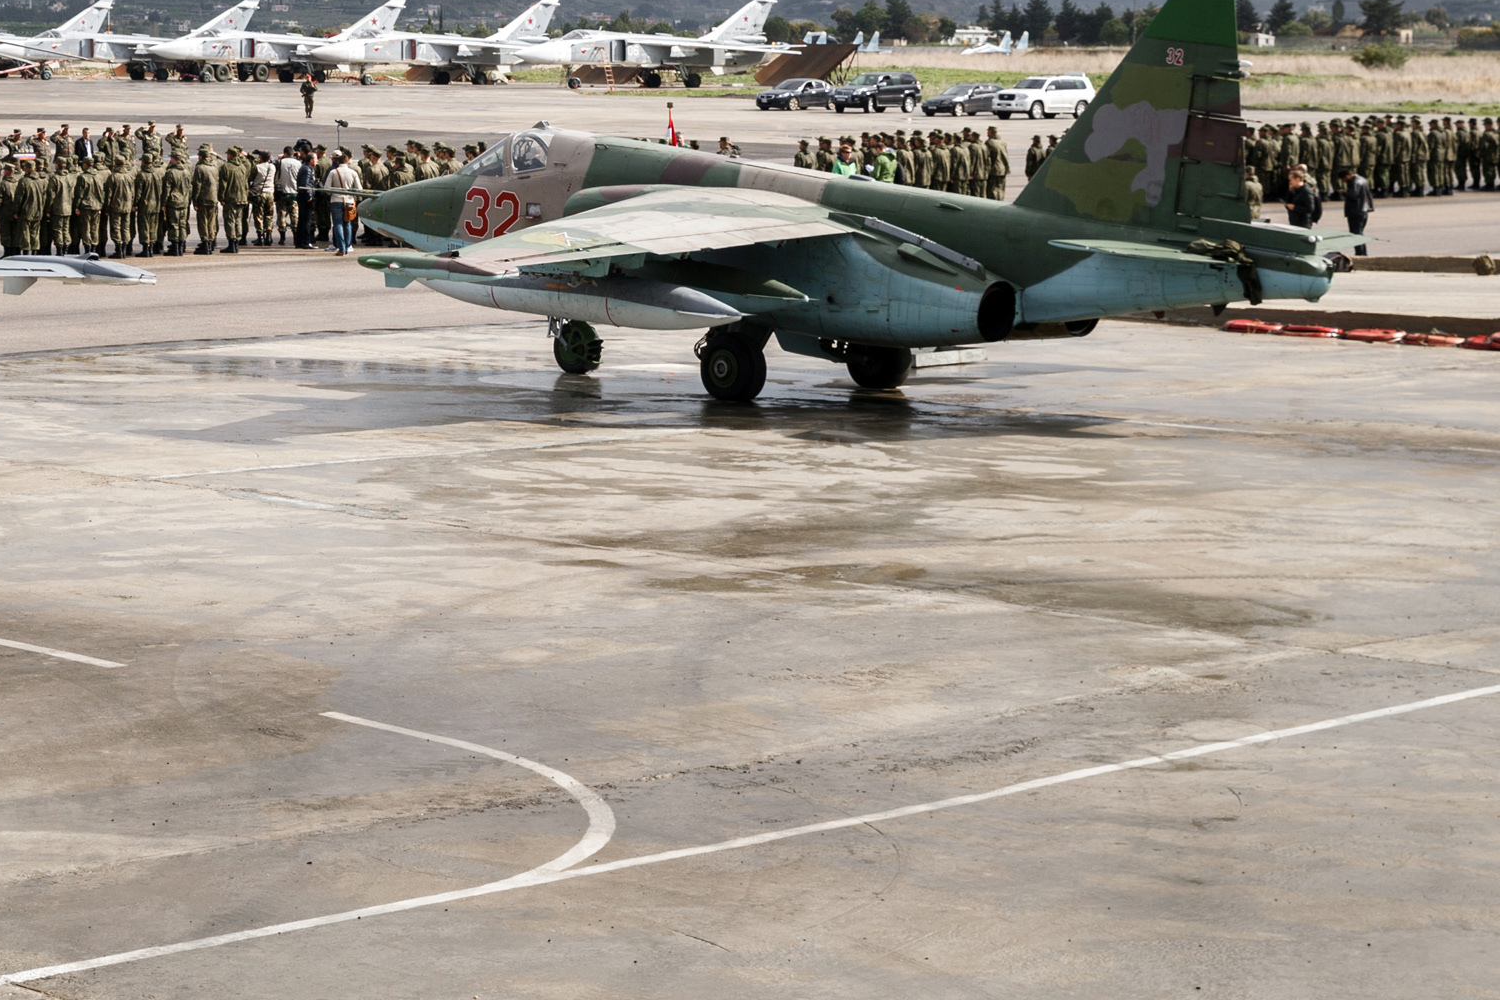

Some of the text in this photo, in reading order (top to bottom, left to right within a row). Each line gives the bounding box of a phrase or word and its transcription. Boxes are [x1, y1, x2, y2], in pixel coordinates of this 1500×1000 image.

[256, 43, 268, 54] 77
[418, 43, 426, 54] 71
[627, 45, 640, 56] 06
[1166, 47, 1184, 66] 32
[464, 184, 521, 238] 32
